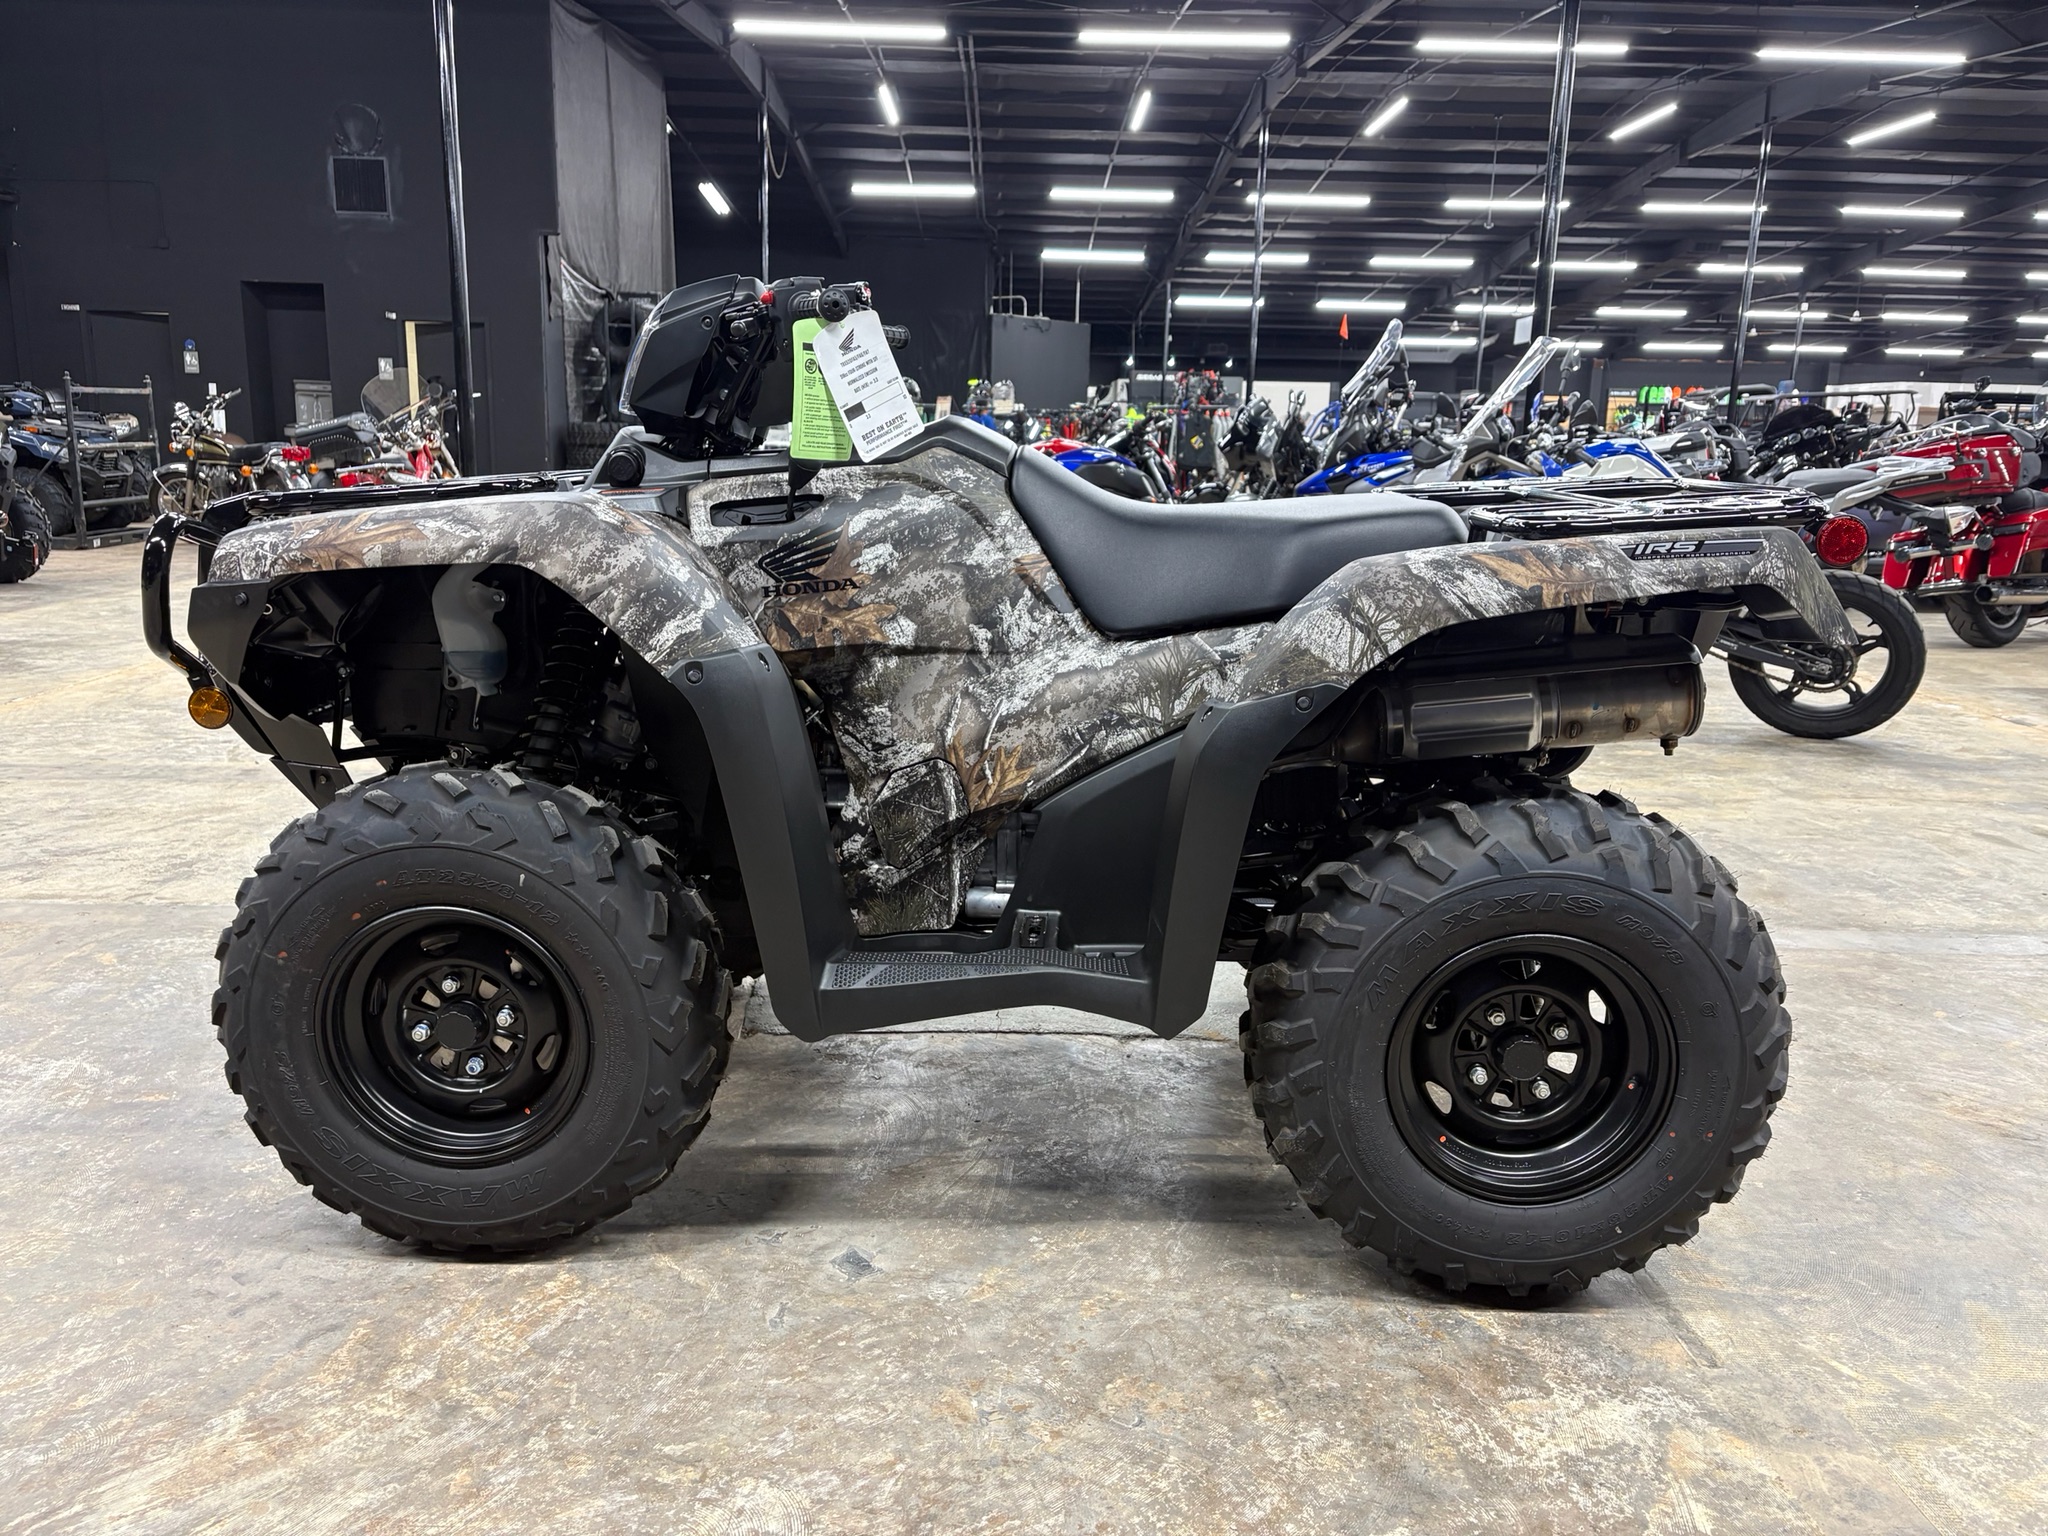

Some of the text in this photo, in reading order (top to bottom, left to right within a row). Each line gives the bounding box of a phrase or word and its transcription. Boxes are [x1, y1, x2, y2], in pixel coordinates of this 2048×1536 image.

[861, 428, 877, 441] BEST
[876, 424, 885, 433] ON
[865, 428, 894, 446] PERFORMANCE
[1634, 541, 1699, 555] IRS
[762, 577, 861, 598] HONDA
[1366, 891, 1605, 1011] MAXXIS
[312, 1126, 547, 1208] MAXXIS
